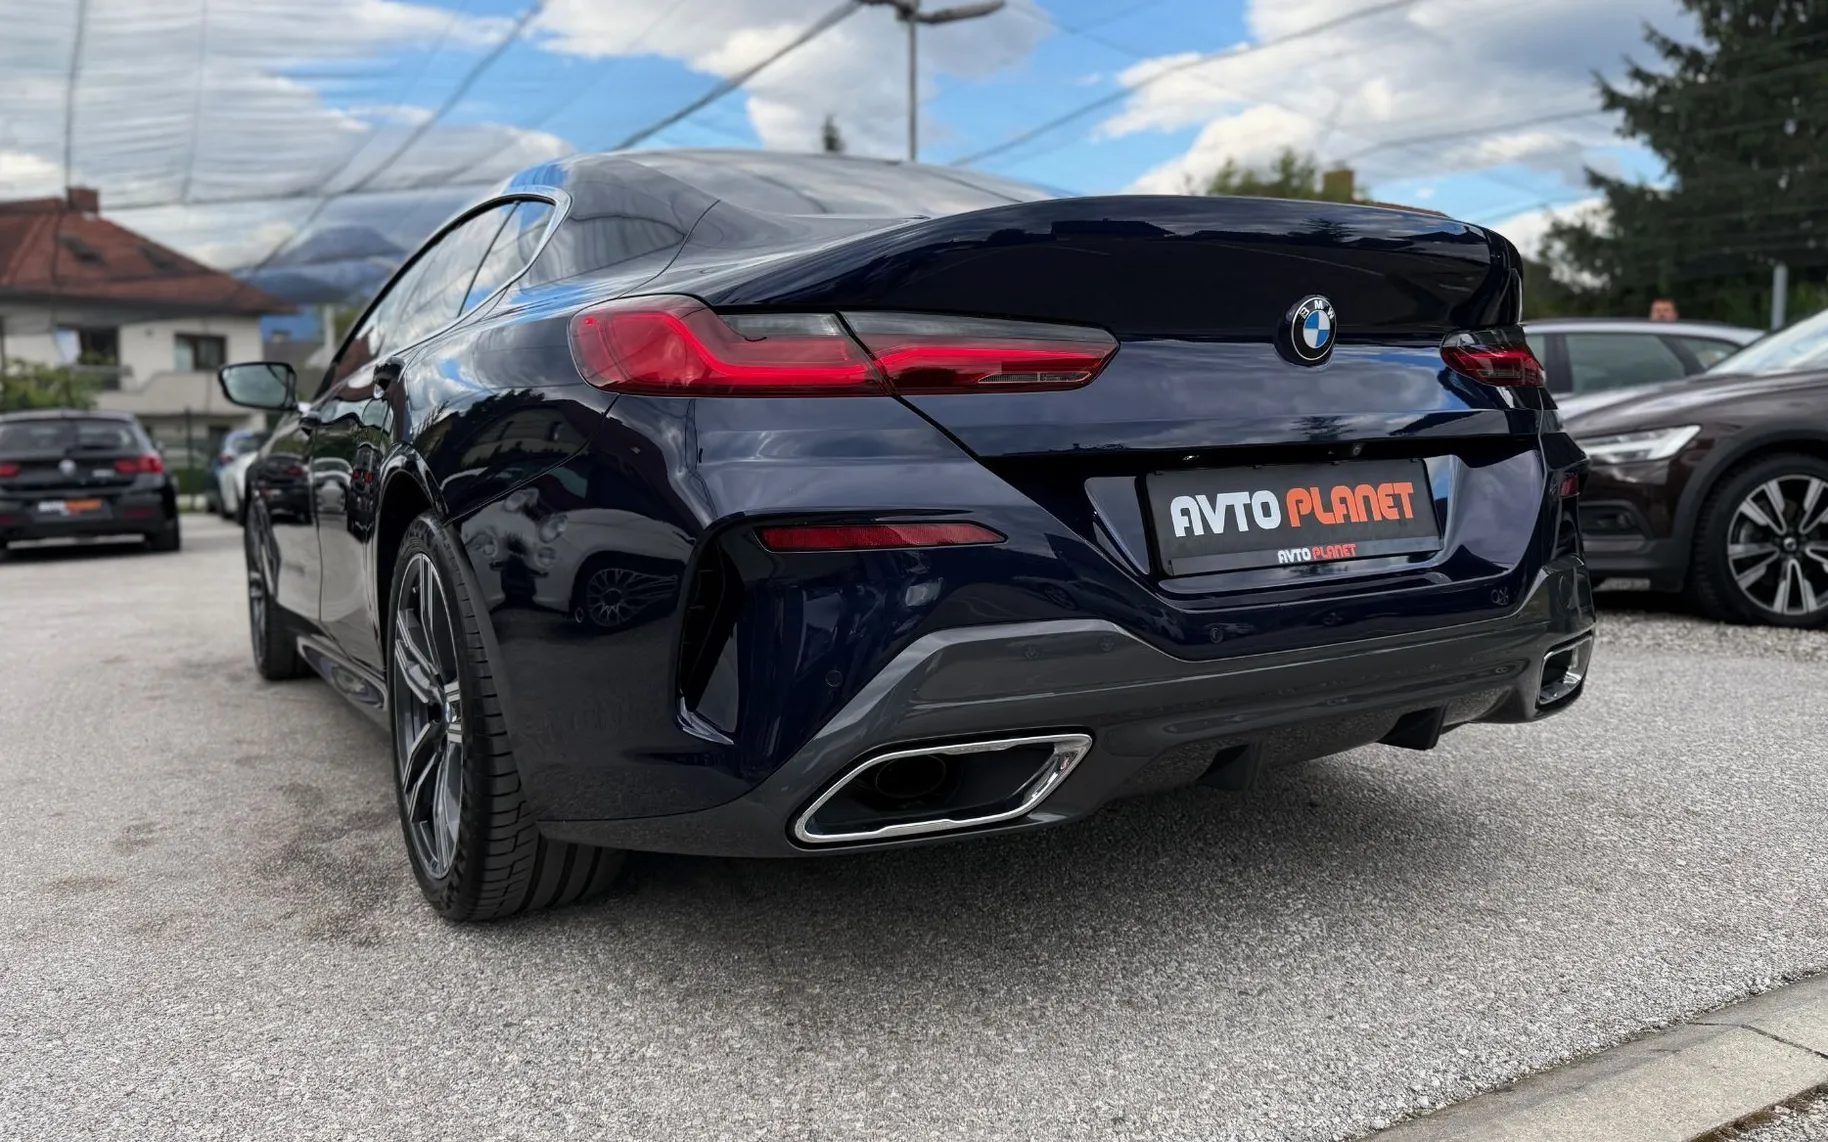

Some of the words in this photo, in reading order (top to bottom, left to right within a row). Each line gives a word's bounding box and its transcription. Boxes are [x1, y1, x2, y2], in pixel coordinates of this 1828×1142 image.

[1299, 299, 1335, 319] BMW
[1170, 490, 1281, 537] AVTO
[1286, 482, 1413, 527] PLANET
[1277, 547, 1312, 564] AVTO
[1312, 543, 1356, 561] PLANET
